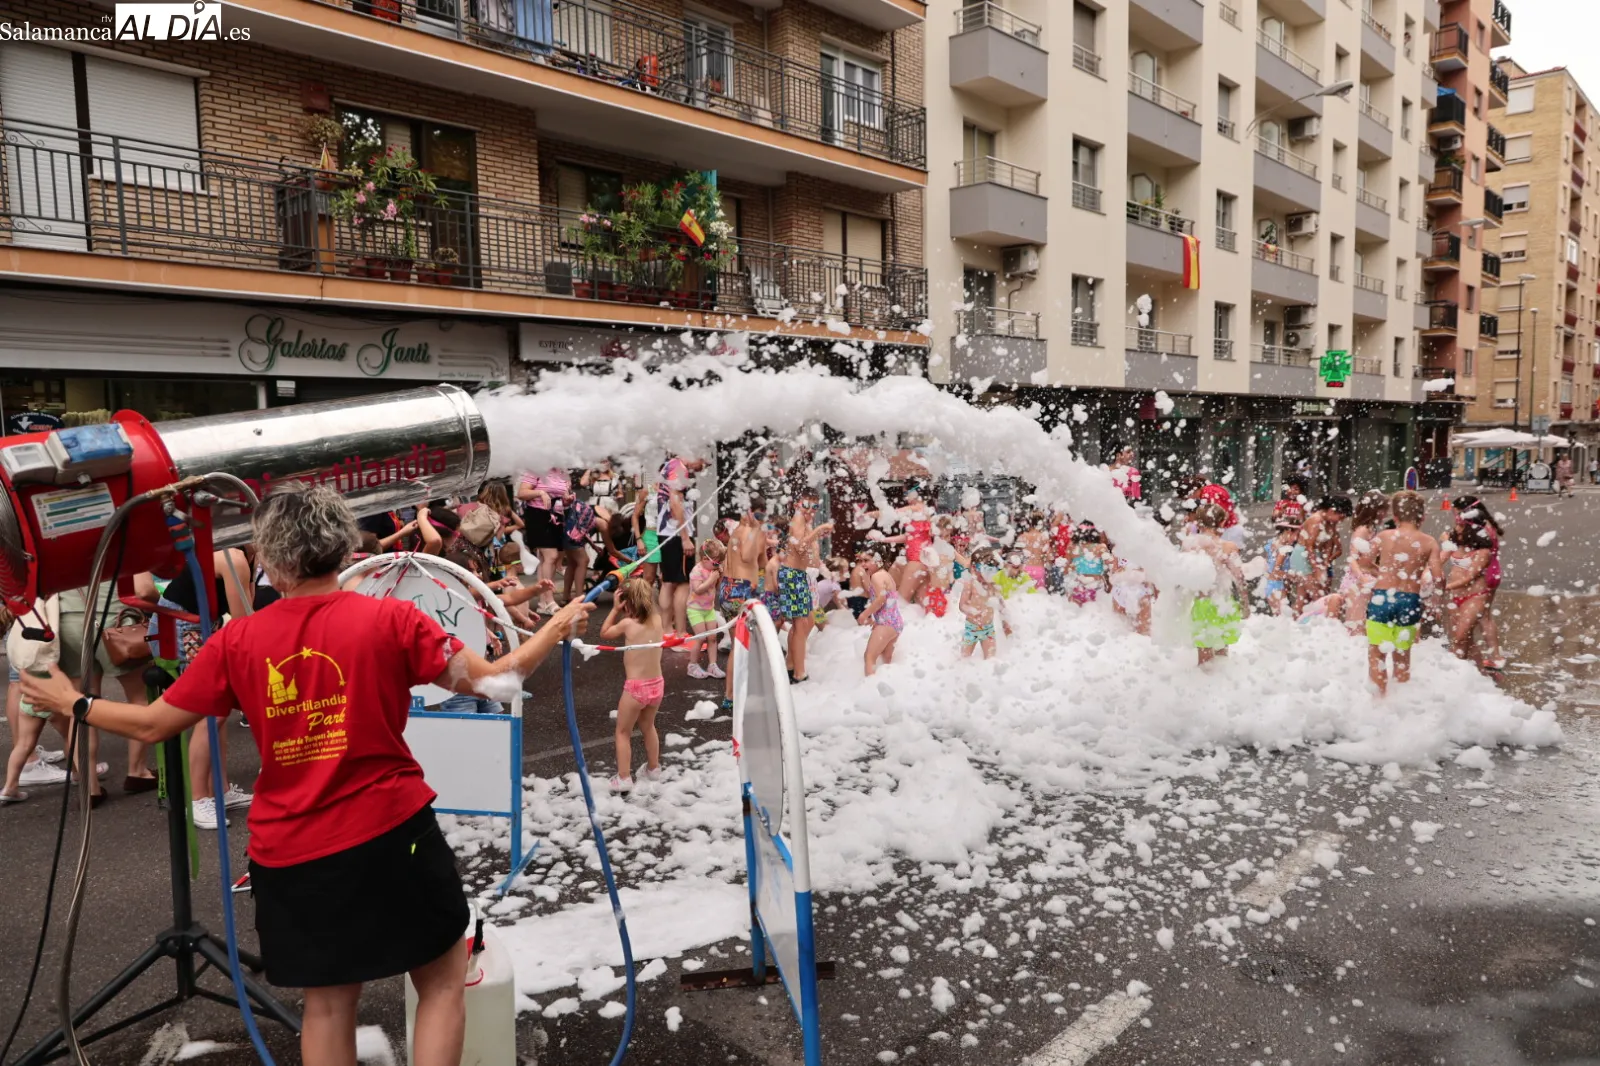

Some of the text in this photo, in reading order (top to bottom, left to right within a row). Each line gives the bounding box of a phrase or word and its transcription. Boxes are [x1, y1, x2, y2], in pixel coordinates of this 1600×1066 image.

[239, 443, 447, 515] Dirtilandia
[265, 694, 348, 719] Divertilandia
[306, 707, 347, 731] Park
